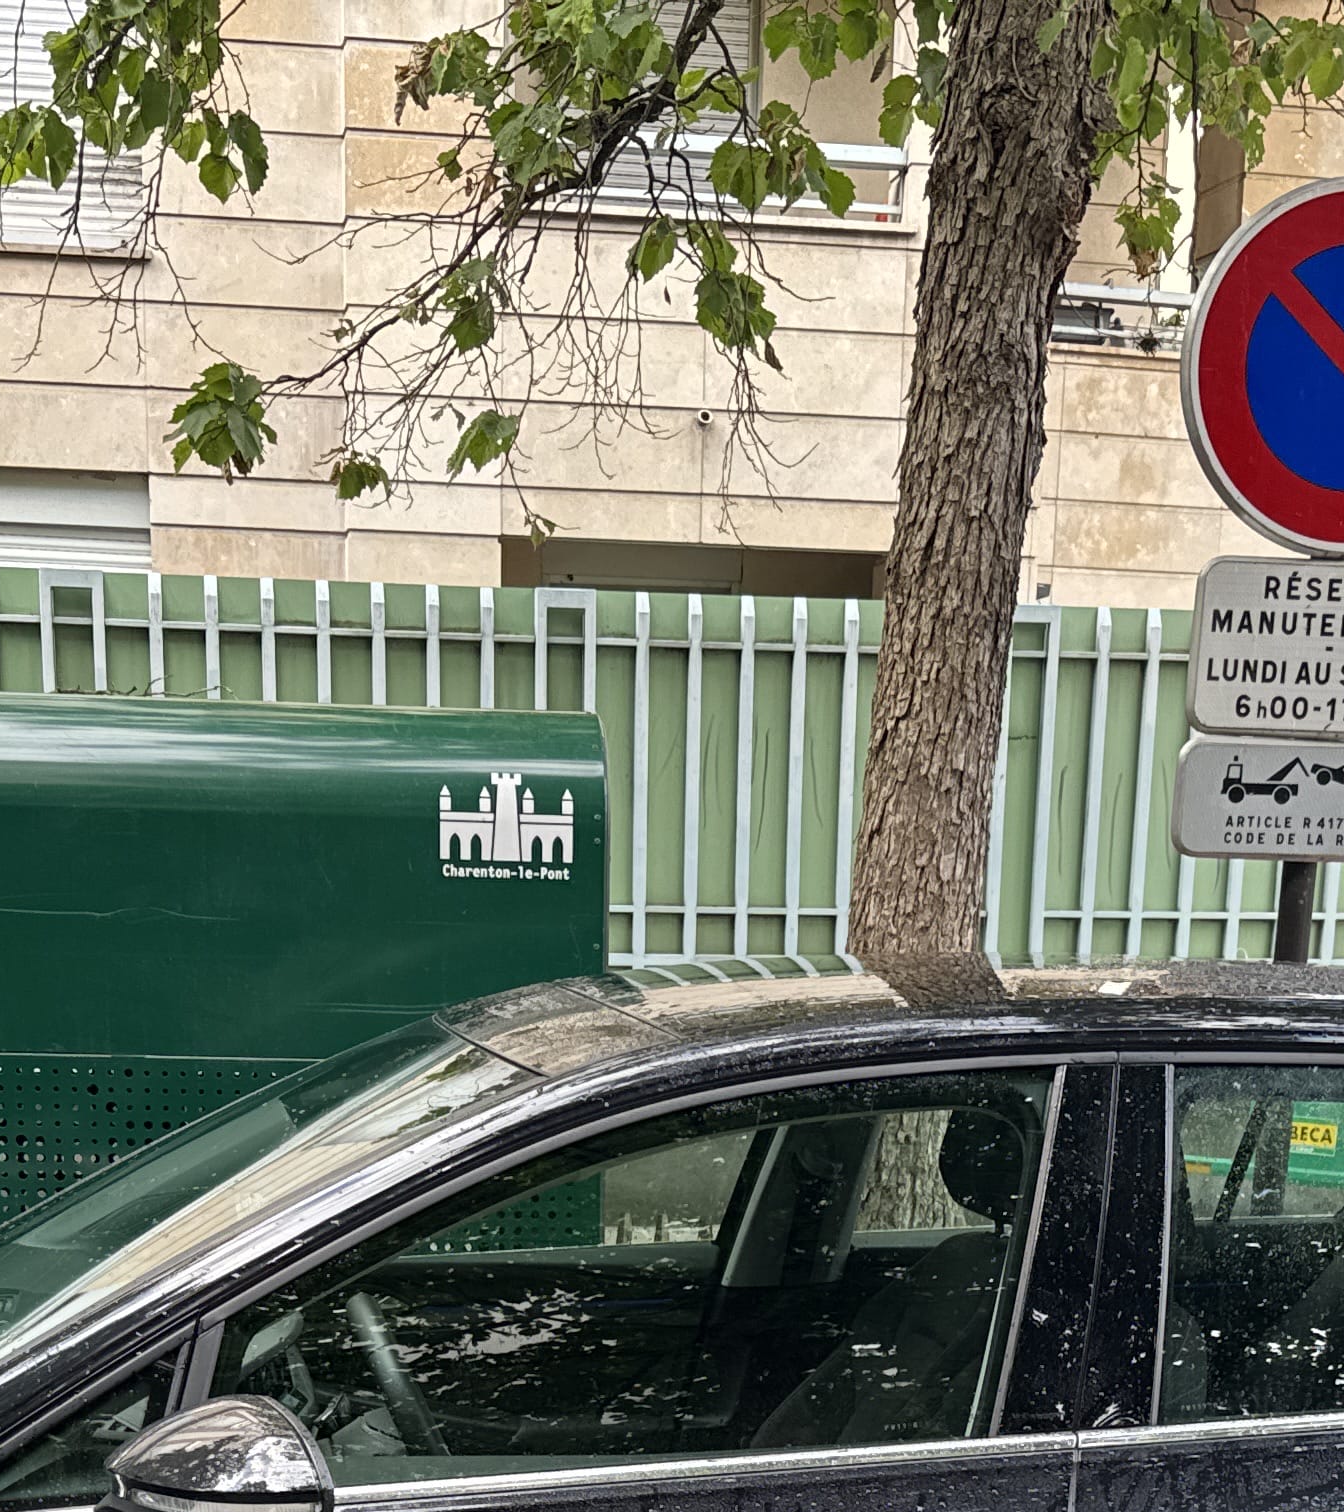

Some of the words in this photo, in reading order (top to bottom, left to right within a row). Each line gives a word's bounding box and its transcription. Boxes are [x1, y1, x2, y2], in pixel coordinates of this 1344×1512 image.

[1206, 657, 1287, 684] LUNDI
[1295, 661, 1332, 685] AU
[1225, 815, 1293, 829] ARTICLE
[1223, 832, 1266, 845] CODE
[1276, 833, 1296, 845] DE
[1306, 833, 1324, 845] LA
[442, 863, 570, 880] Charenton-le-Pont
[1291, 1126, 1332, 1144] BECA
